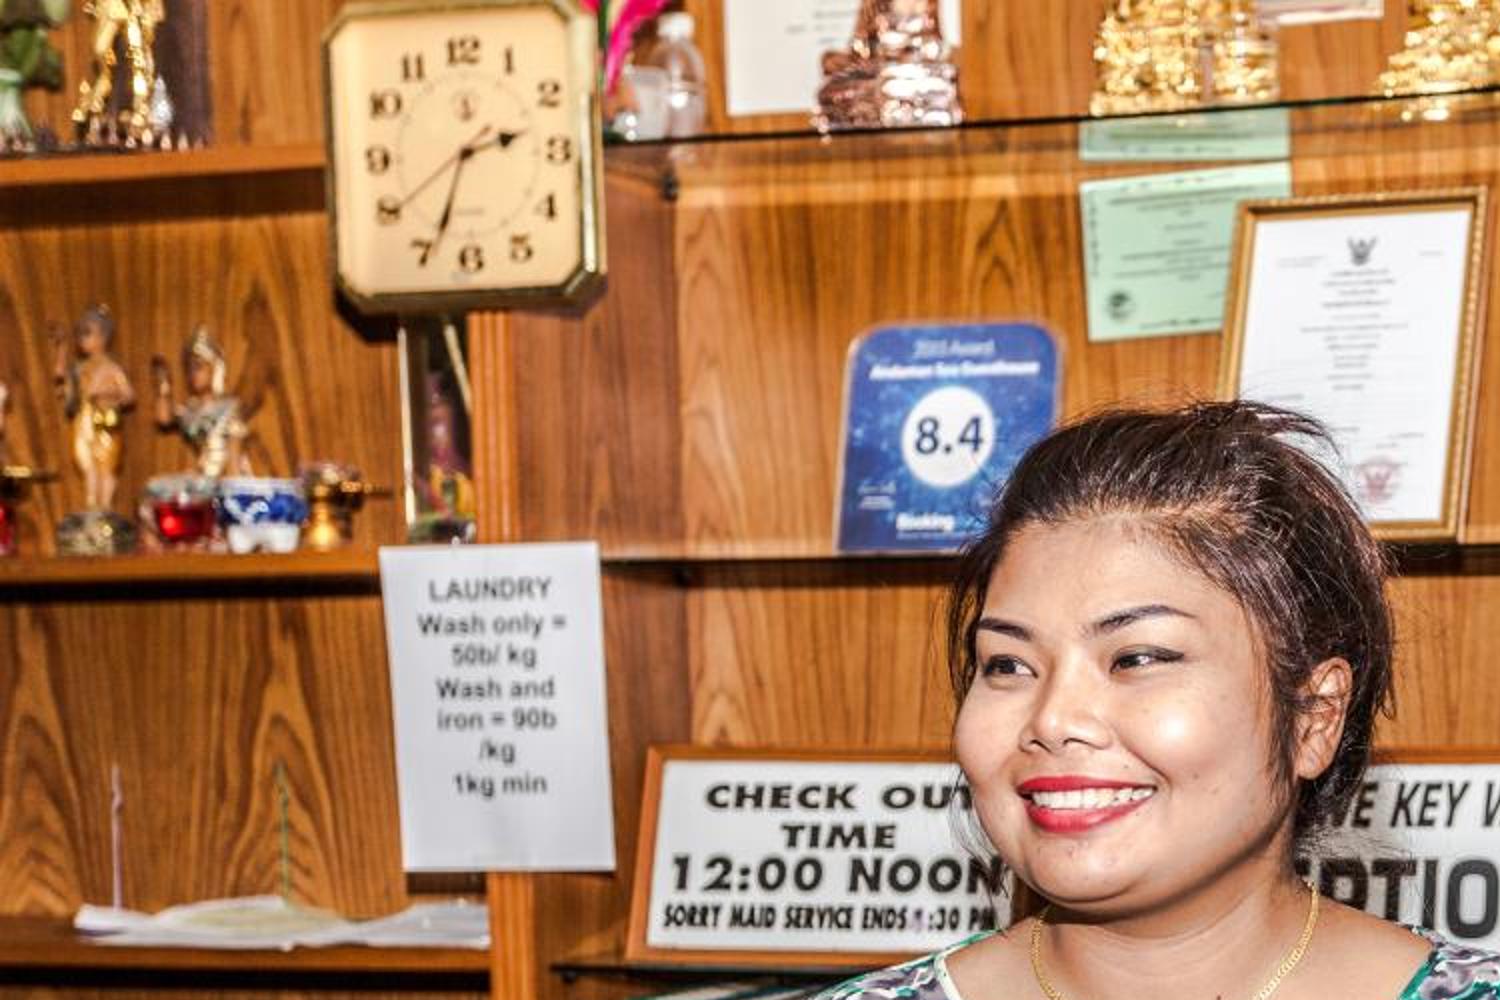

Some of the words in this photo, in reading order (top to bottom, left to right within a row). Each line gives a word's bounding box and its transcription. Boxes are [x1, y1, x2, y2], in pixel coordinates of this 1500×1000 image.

[446, 36, 480, 66] 12
[504, 47, 515, 75] 1
[402, 54, 425, 81] 11
[369, 91, 402, 119] 10
[537, 80, 560, 108] 2
[366, 147, 390, 174] 9
[547, 136, 571, 164] 3
[377, 198, 402, 225] 8
[535, 193, 558, 221] 4
[411, 239, 433, 267] 7
[459, 245, 484, 274] 6
[509, 234, 534, 263] 5
[914, 415, 983, 455] 8.4
[429, 576, 552, 602] LAUNDRY
[417, 611, 486, 636] Wash
[493, 611, 544, 639] only
[507, 643, 537, 670] kg
[436, 676, 502, 700] Wash
[510, 676, 555, 698] and
[512, 707, 557, 731] 90b
[455, 773, 495, 797] 1kg
[502, 772, 548, 793] min
[706, 784, 857, 810] CHECK
[1390, 781, 1471, 828] KEY
[780, 823, 897, 849] TIME
[671, 856, 824, 893] 12:00
[848, 855, 1003, 896] NOON
[664, 904, 722, 928] SORRY
[784, 905, 854, 929] SERVICE
[861, 905, 908, 930] ENDS
